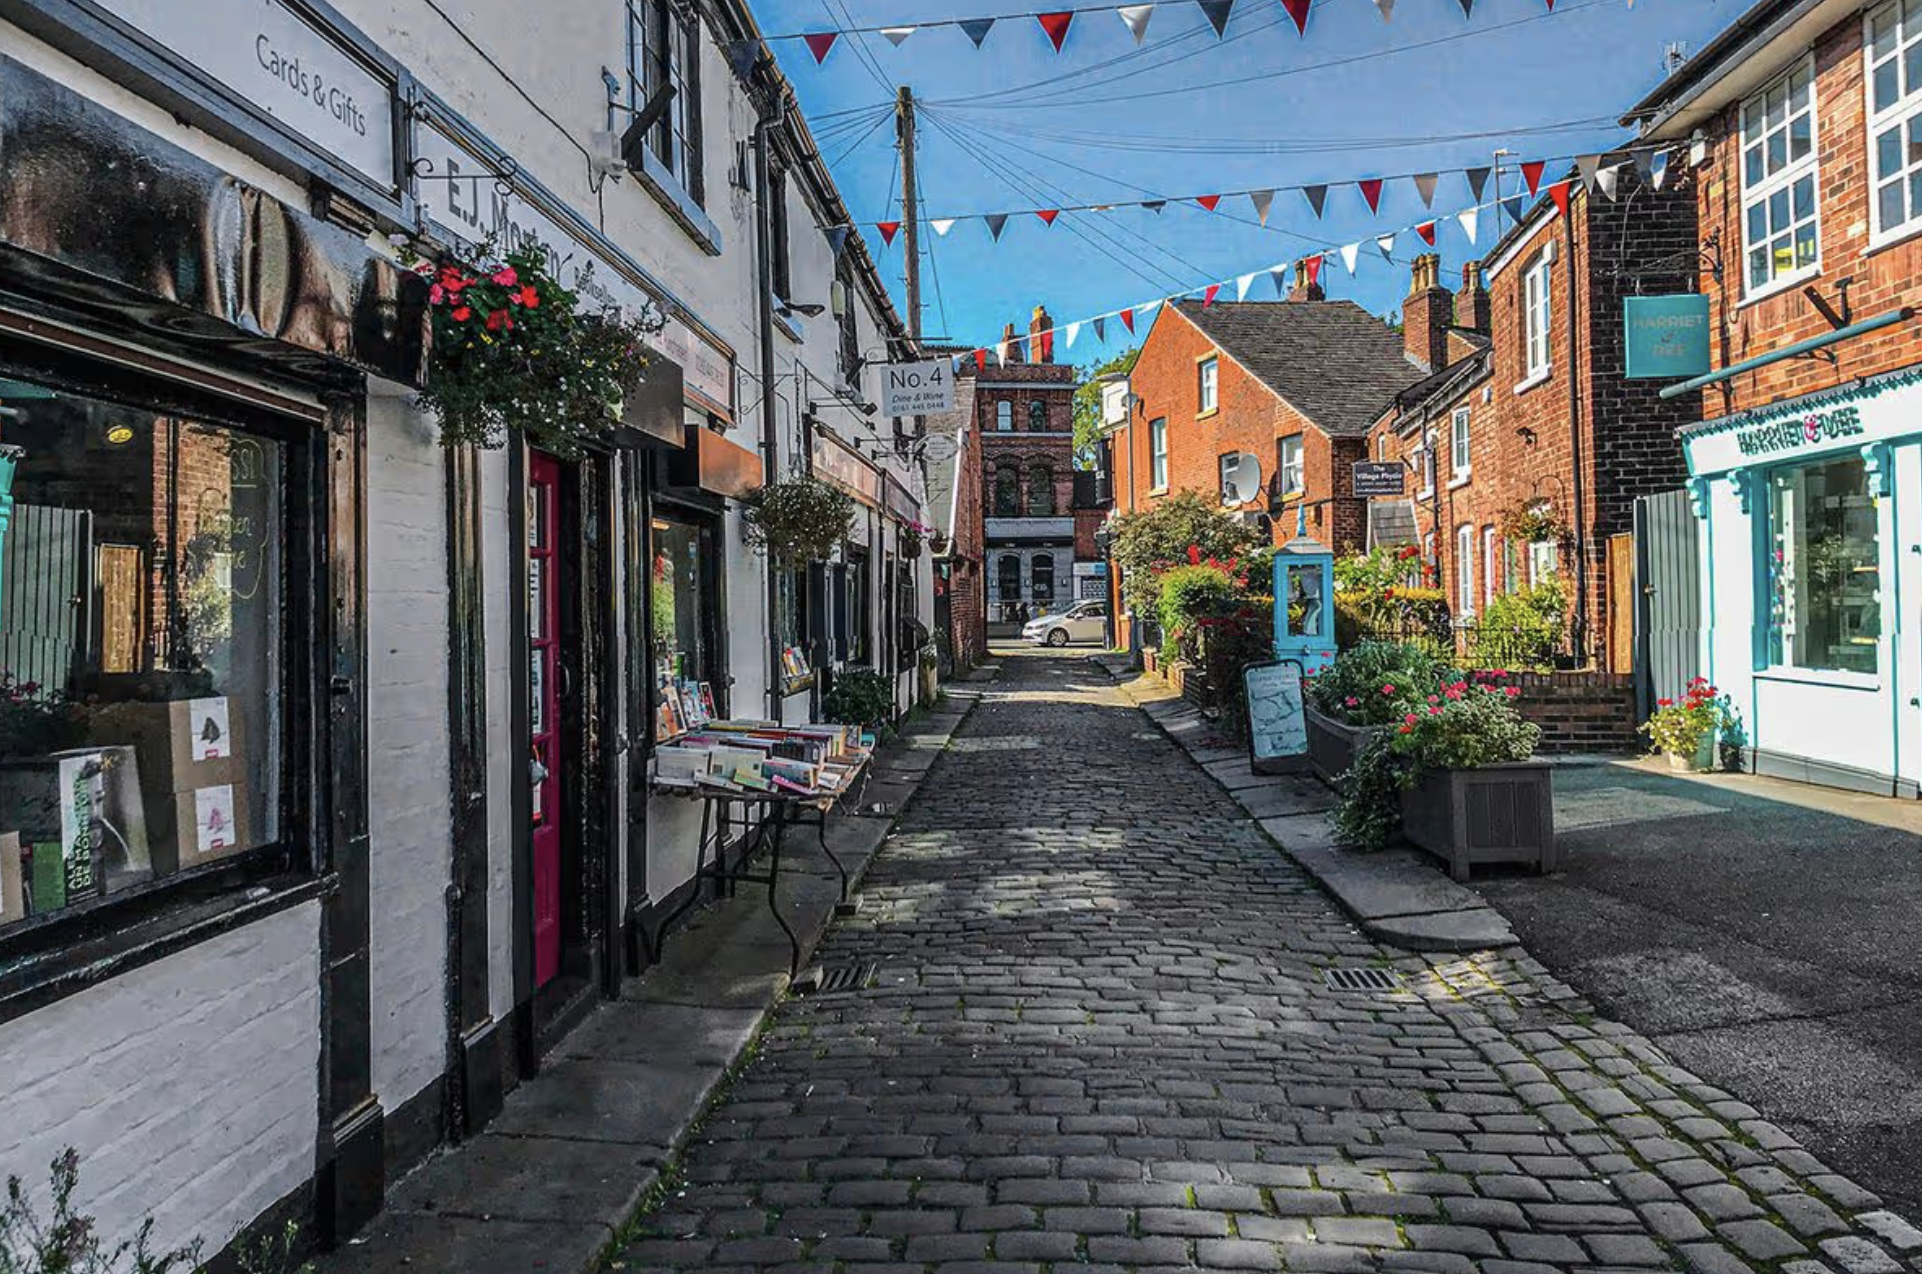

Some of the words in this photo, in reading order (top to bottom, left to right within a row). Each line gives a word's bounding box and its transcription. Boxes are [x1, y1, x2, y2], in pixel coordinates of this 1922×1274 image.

[256, 34, 308, 97] Cards
[313, 74, 326, 110] &
[329, 87, 366, 136] Gifts
[1633, 315, 1704, 329] HARRIET
[892, 394, 912, 403] Dine
[914, 393, 921, 402] &
[923, 392, 944, 401] Wine
[1356, 473, 1379, 481] Village
